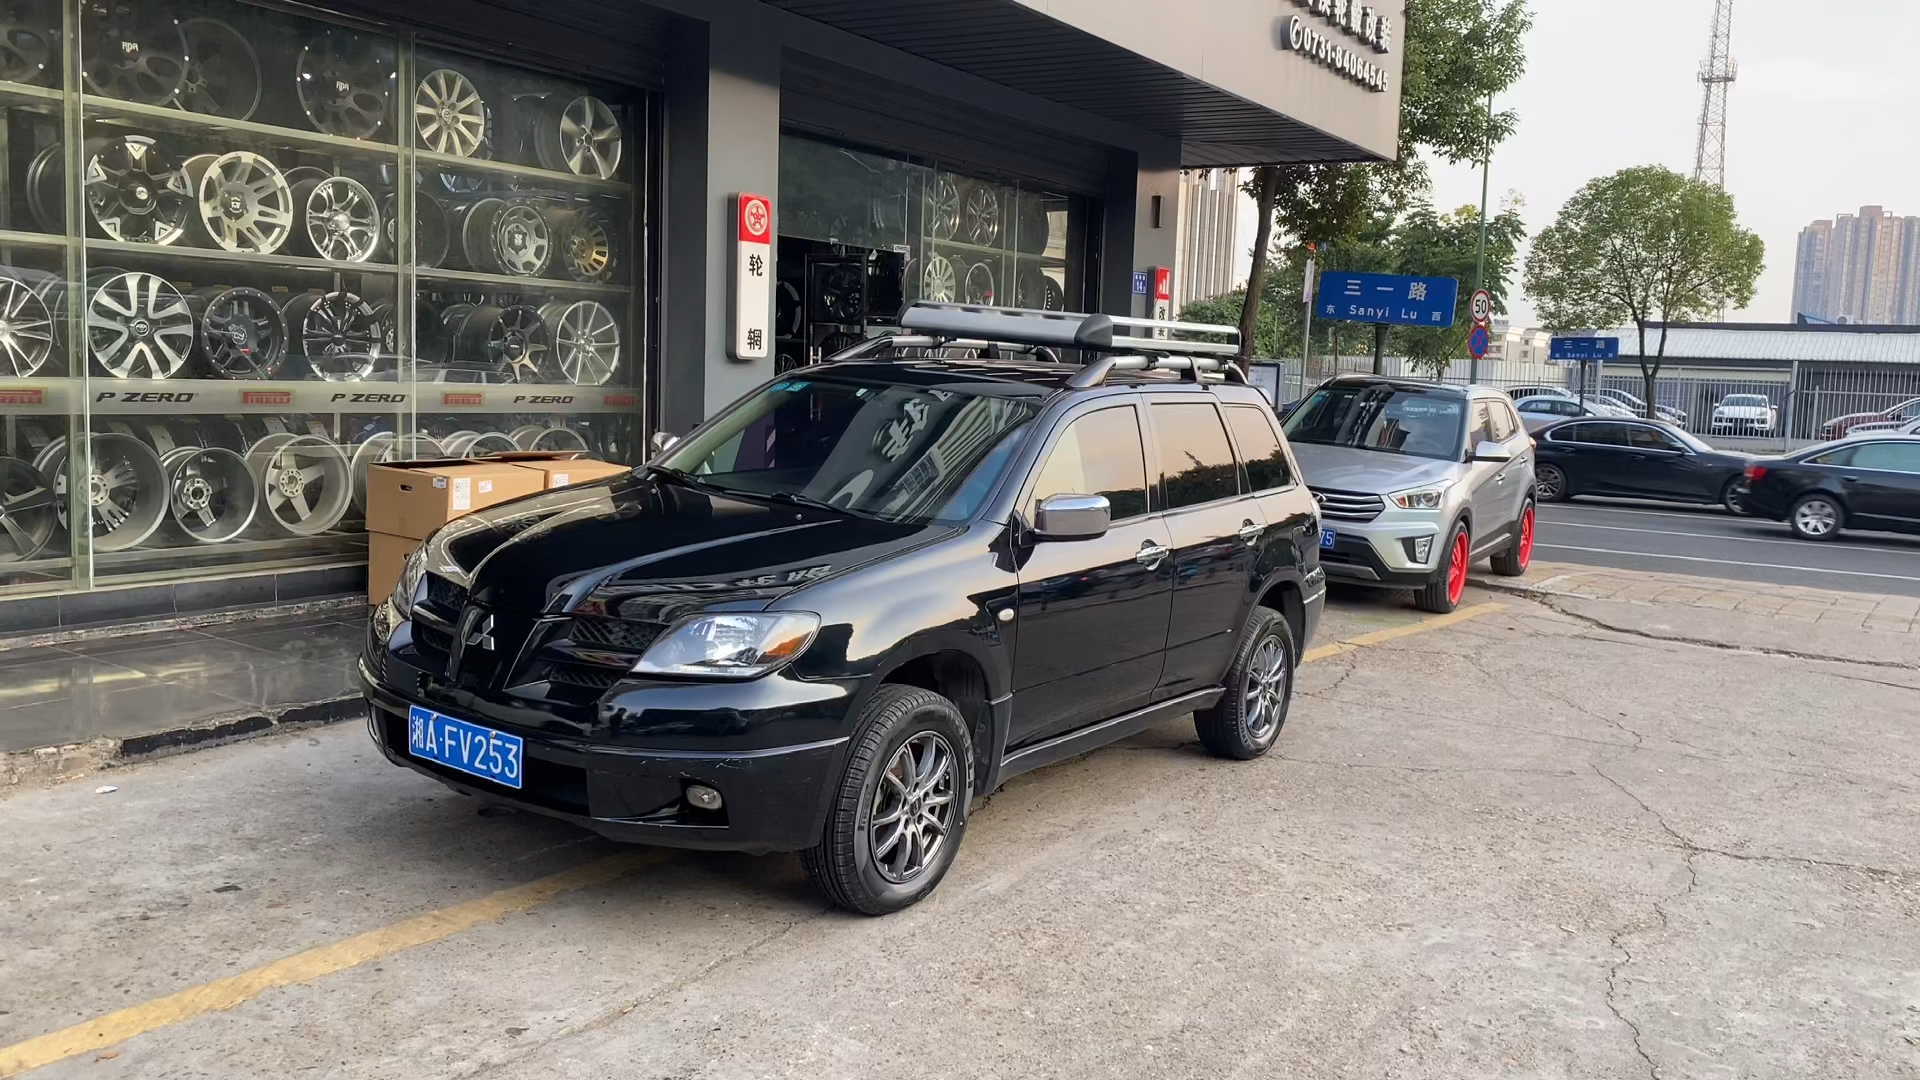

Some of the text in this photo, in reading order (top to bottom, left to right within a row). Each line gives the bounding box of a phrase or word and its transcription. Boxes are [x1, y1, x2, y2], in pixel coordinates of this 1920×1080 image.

[1304, 27, 1389, 91] 0731-84064545
[1344, 279, 1427, 301] 三一路
[747, 253, 764, 351] 轮辋
[1475, 299, 1487, 314] 50
[1326, 304, 1442, 322] 东 Sanyi Lu 西
[96, 392, 195, 403] P ZERO
[330, 393, 407, 403] P ZERO
[513, 395, 574, 404] P ZERO
